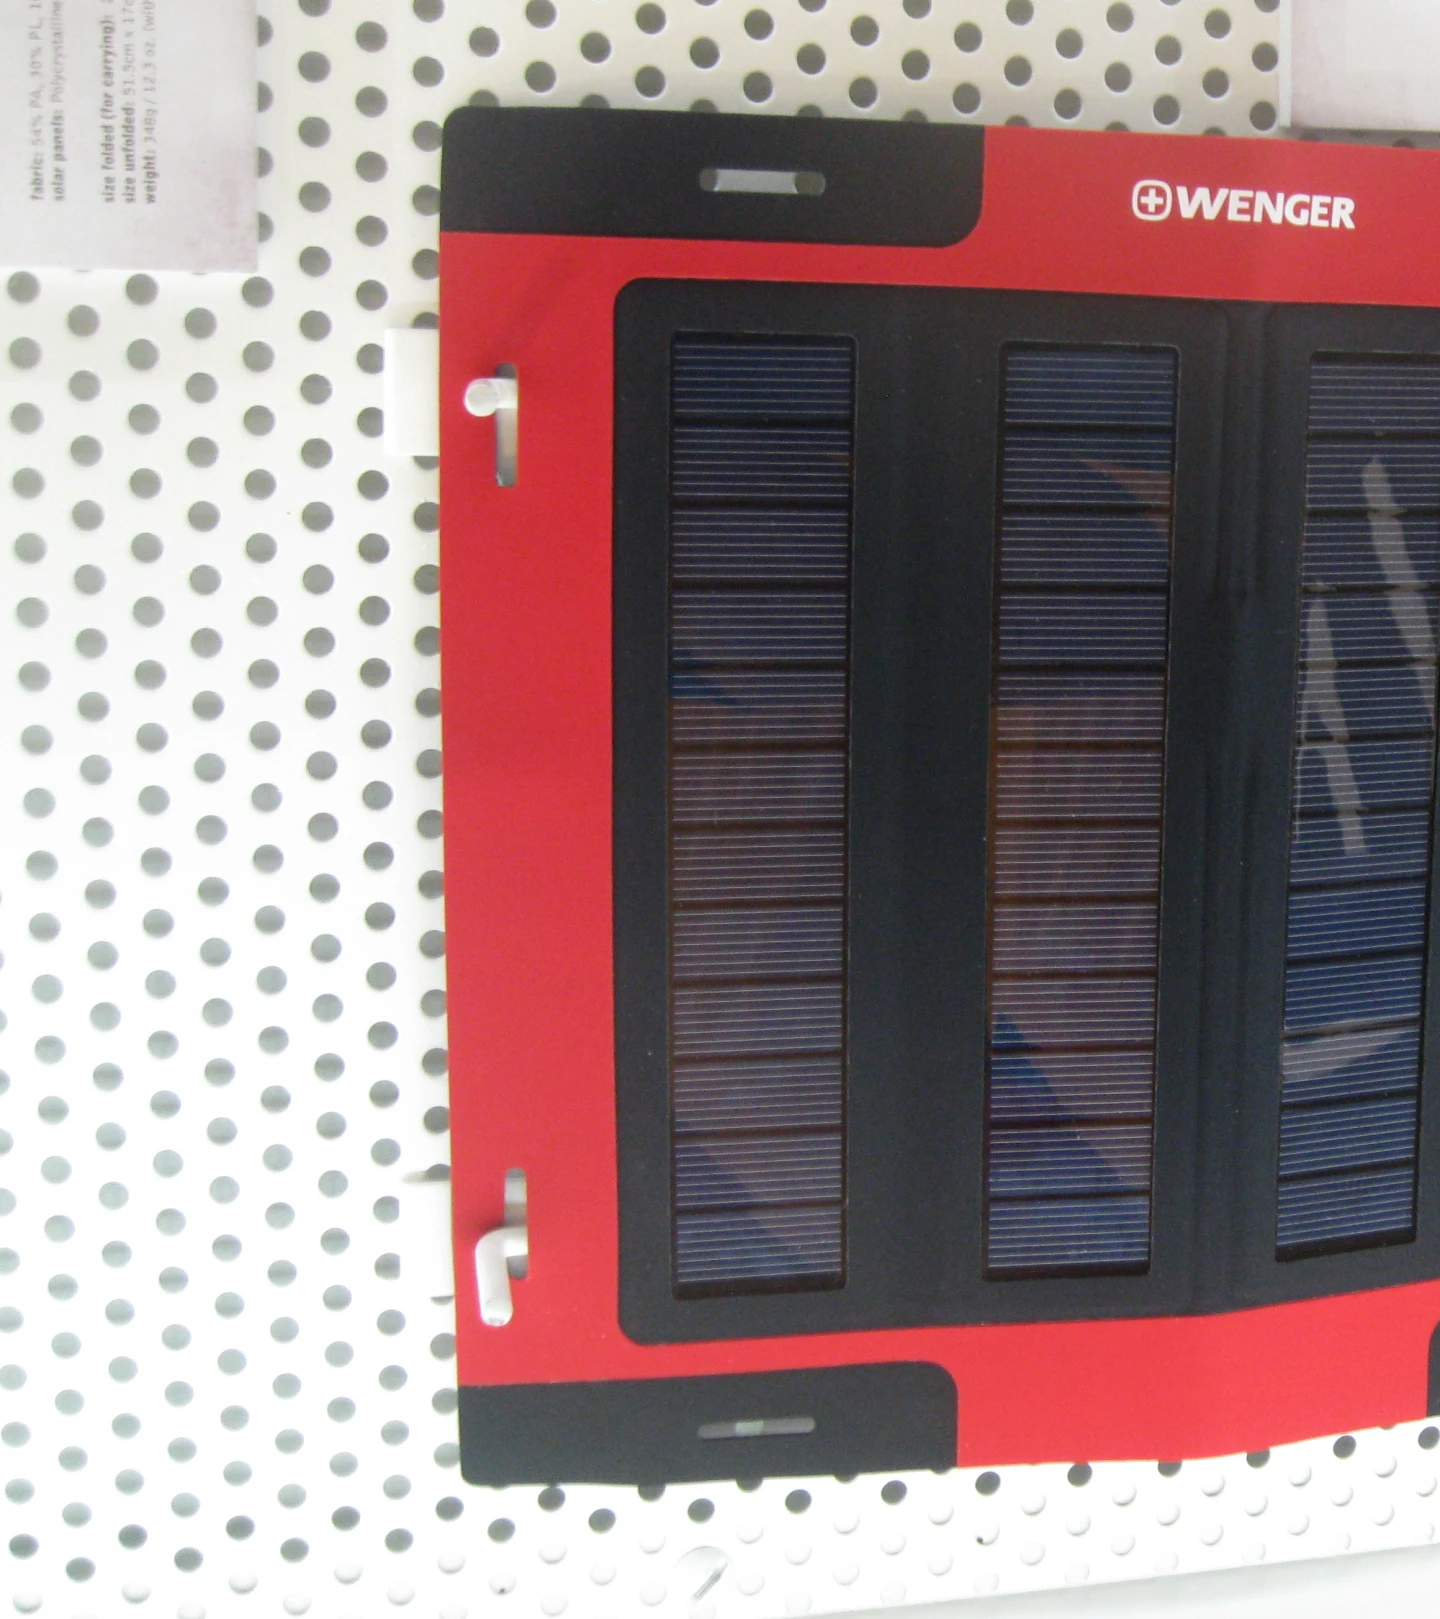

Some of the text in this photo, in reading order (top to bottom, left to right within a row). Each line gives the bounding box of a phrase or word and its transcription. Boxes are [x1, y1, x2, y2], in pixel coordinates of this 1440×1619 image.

[100, 14, 116, 87] carrying):
[101, 93, 117, 119] (for
[31, 115, 43, 146] 54%
[51, 109, 67, 162] panels:
[100, 125, 115, 170] folded
[121, 102, 136, 171] unfolded:
[30, 152, 44, 200] fabric:
[51, 166, 65, 201] solar
[101, 177, 115, 203] size
[122, 177, 136, 204] size
[143, 149, 159, 204] weight:
[1176, 185, 1356, 229] WENGER
